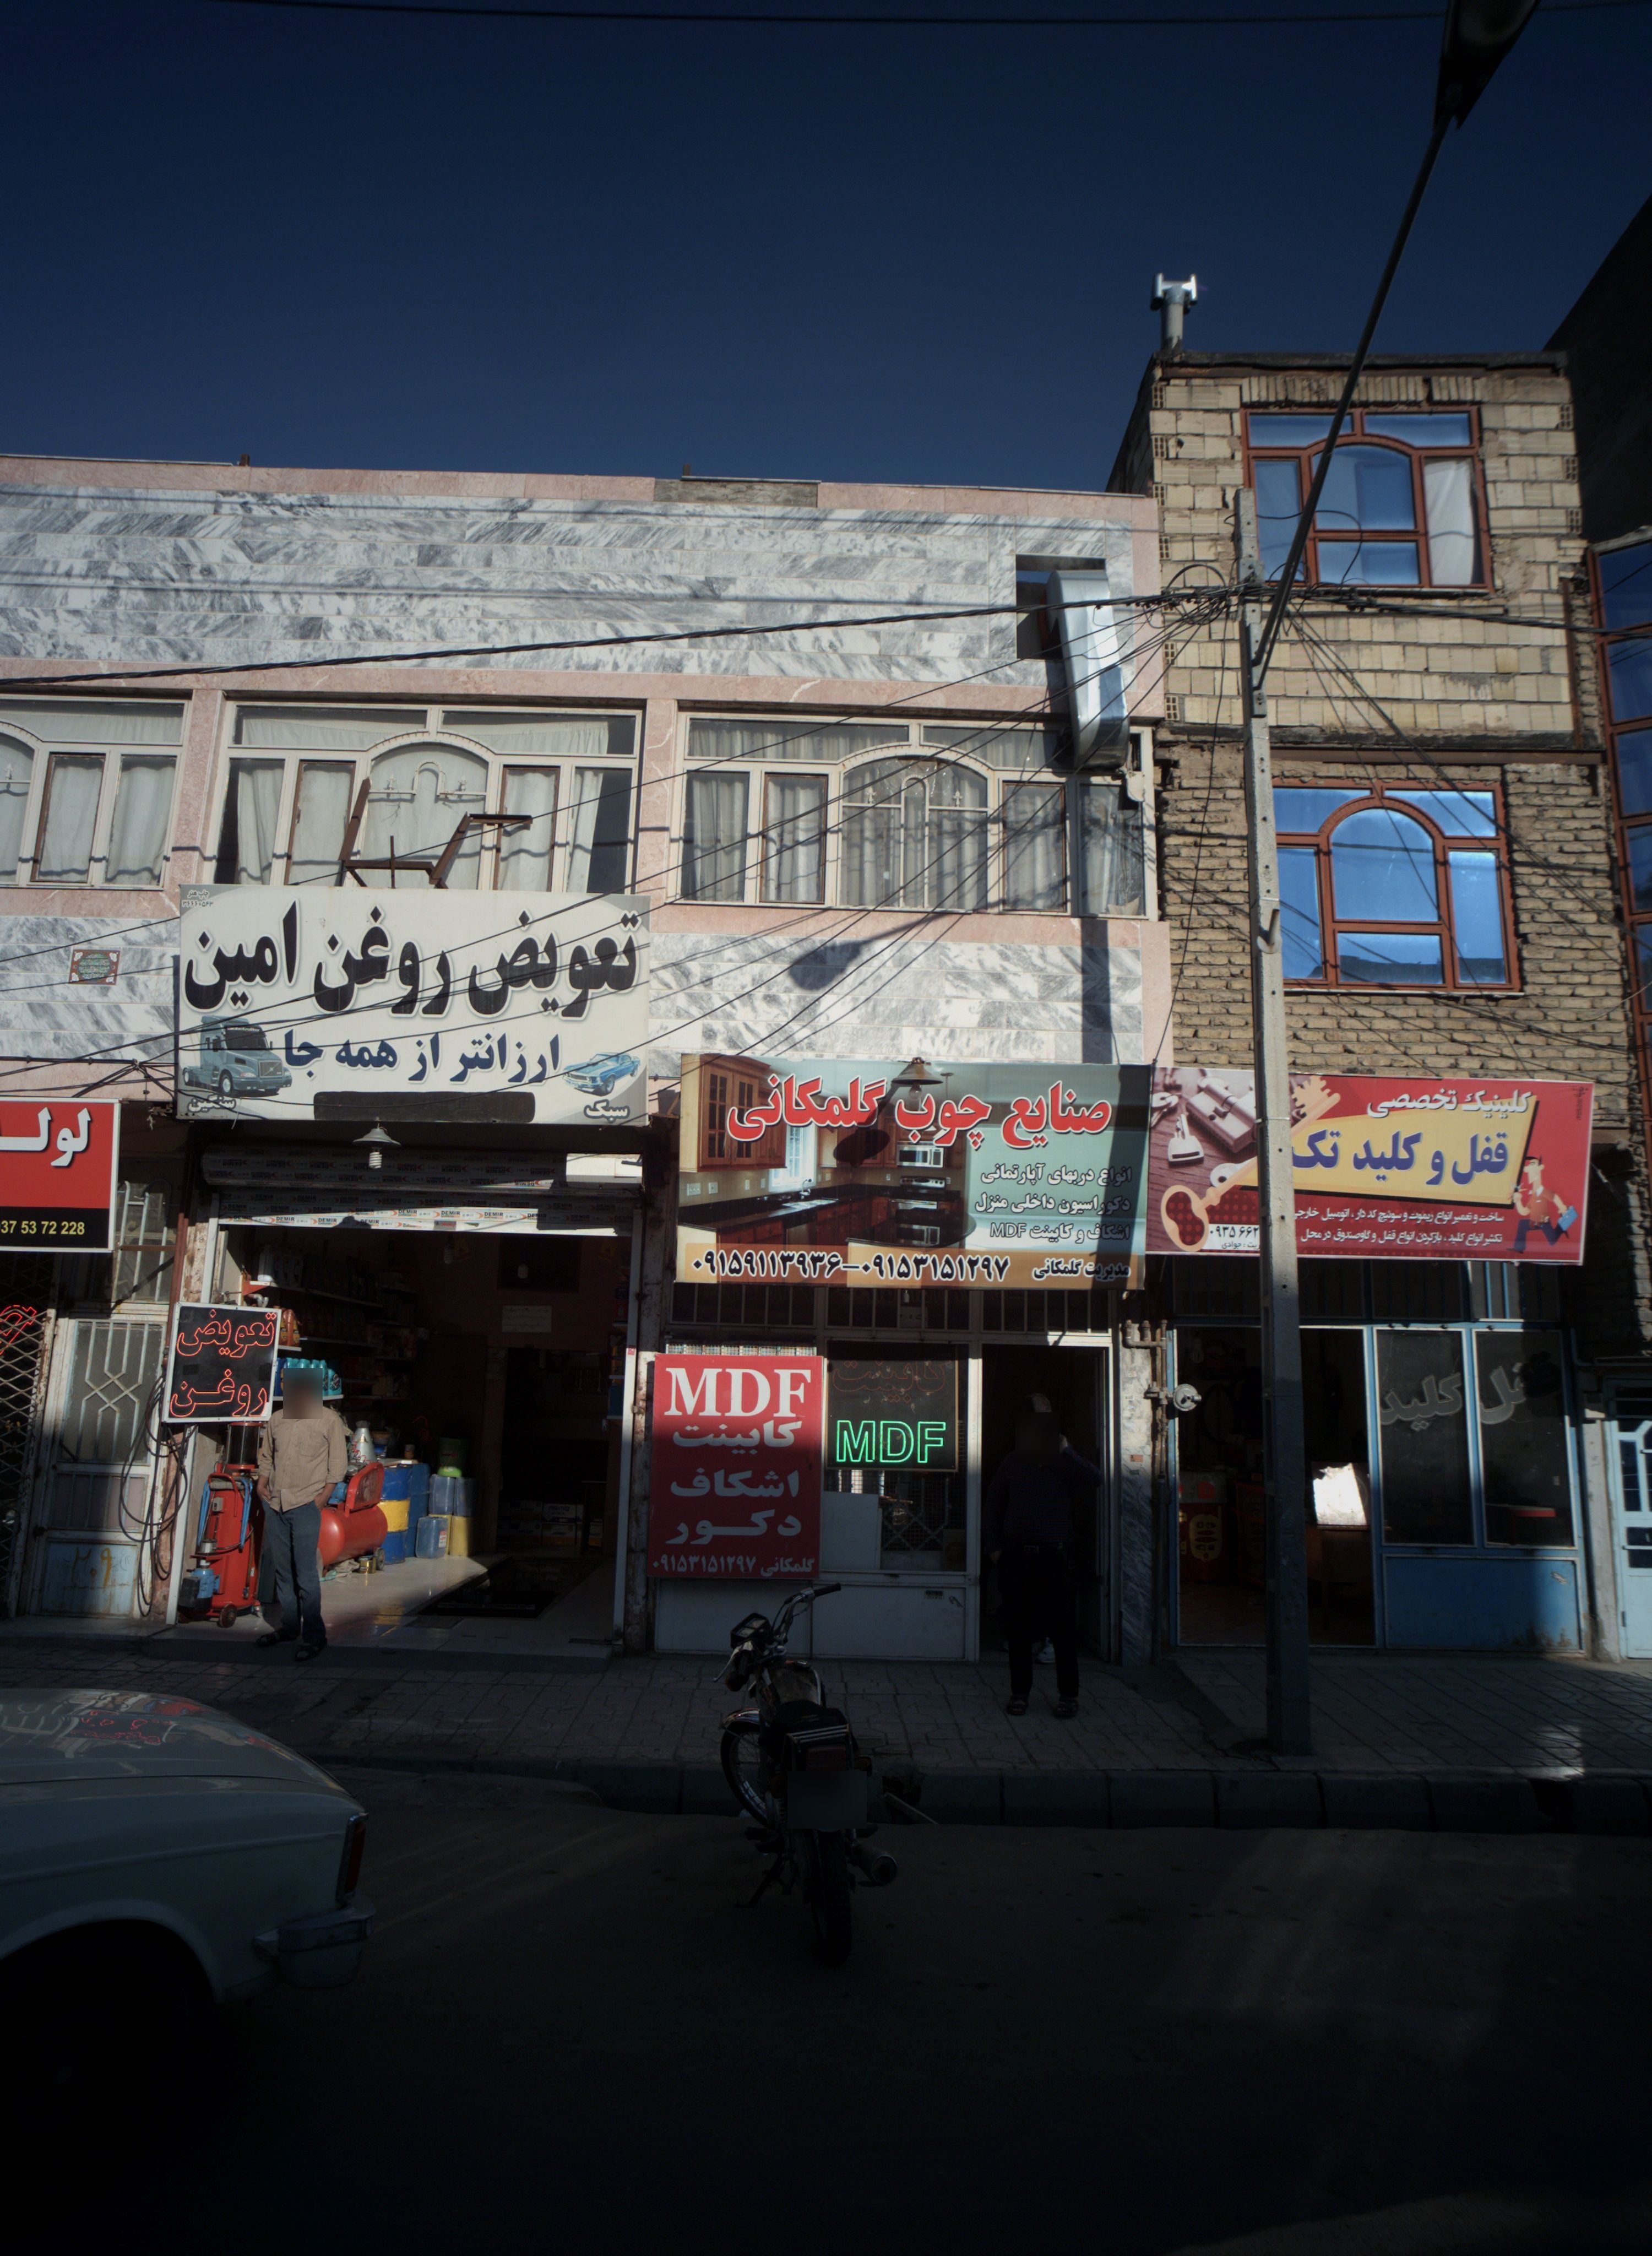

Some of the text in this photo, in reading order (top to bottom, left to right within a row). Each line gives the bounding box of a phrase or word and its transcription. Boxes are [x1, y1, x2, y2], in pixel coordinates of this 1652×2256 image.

[184, 900, 638, 1017] تعویض روغن امین
[284, 1028, 324, 1080] جا
[335, 1039, 398, 1070] همه
[409, 1032, 442, 1082] از
[187, 1093, 236, 1113] سنگین
[584, 1099, 631, 1124] سبک
[726, 1073, 1111, 1150] صنایع چوب گلمکانی
[1367, 1087, 1458, 1118] تخصصی
[1352, 1130, 1423, 1181] کلید
[1426, 1149, 1446, 1185] و
[1452, 1131, 1508, 1185] قفل
[981, 1163, 1132, 1186] انواع دربهای آپارتمانی
[975, 1192, 1131, 1215] دکوراسیون داخلی منزل
[1434, 1211, 1453, 1224] انواع
[1, 1220, 85, 1235] 37 53 72 228
[990, 1222, 1130, 1244] اشکاف و کابینت MDF
[1210, 1225, 1236, 1238] ۰۹۳۵
[1301, 1229, 1322, 1243] محل
[1032, 1258, 1131, 1281] مدیریت گلمکانی
[177, 1309, 276, 1358] تعویض
[170, 1368, 268, 1417] روغن
[664, 1367, 811, 1417] MDF
[1381, 1371, 1463, 1431] کلید
[672, 1420, 803, 1455] کابینت
[836, 1420, 947, 1463] MDF
[670, 1467, 800, 1498] اشکاف
[665, 1509, 802, 1544] دکور
[652, 1553, 815, 1577] ۰۹۱۵۳۱۵۱۲۹۷ گلمکانی
